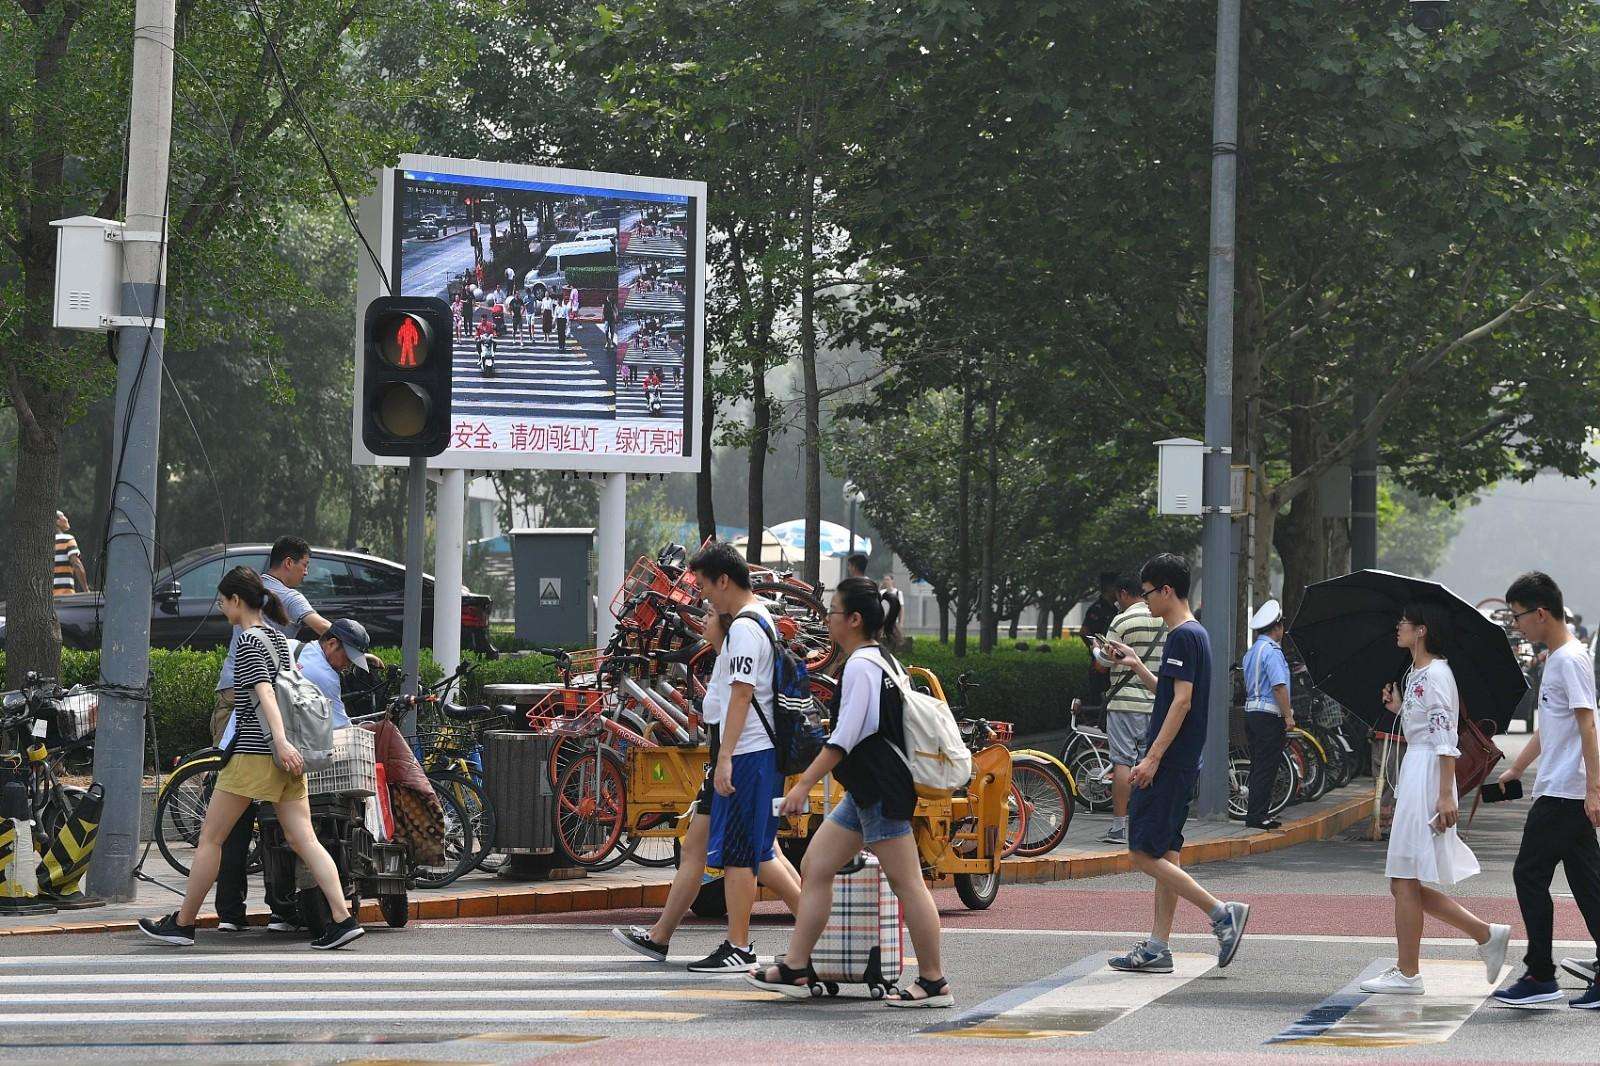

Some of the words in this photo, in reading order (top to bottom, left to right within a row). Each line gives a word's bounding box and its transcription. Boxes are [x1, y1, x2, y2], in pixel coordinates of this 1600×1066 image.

[448, 421, 684, 455] 安全。请勿闯红灯，绿灯亮时
